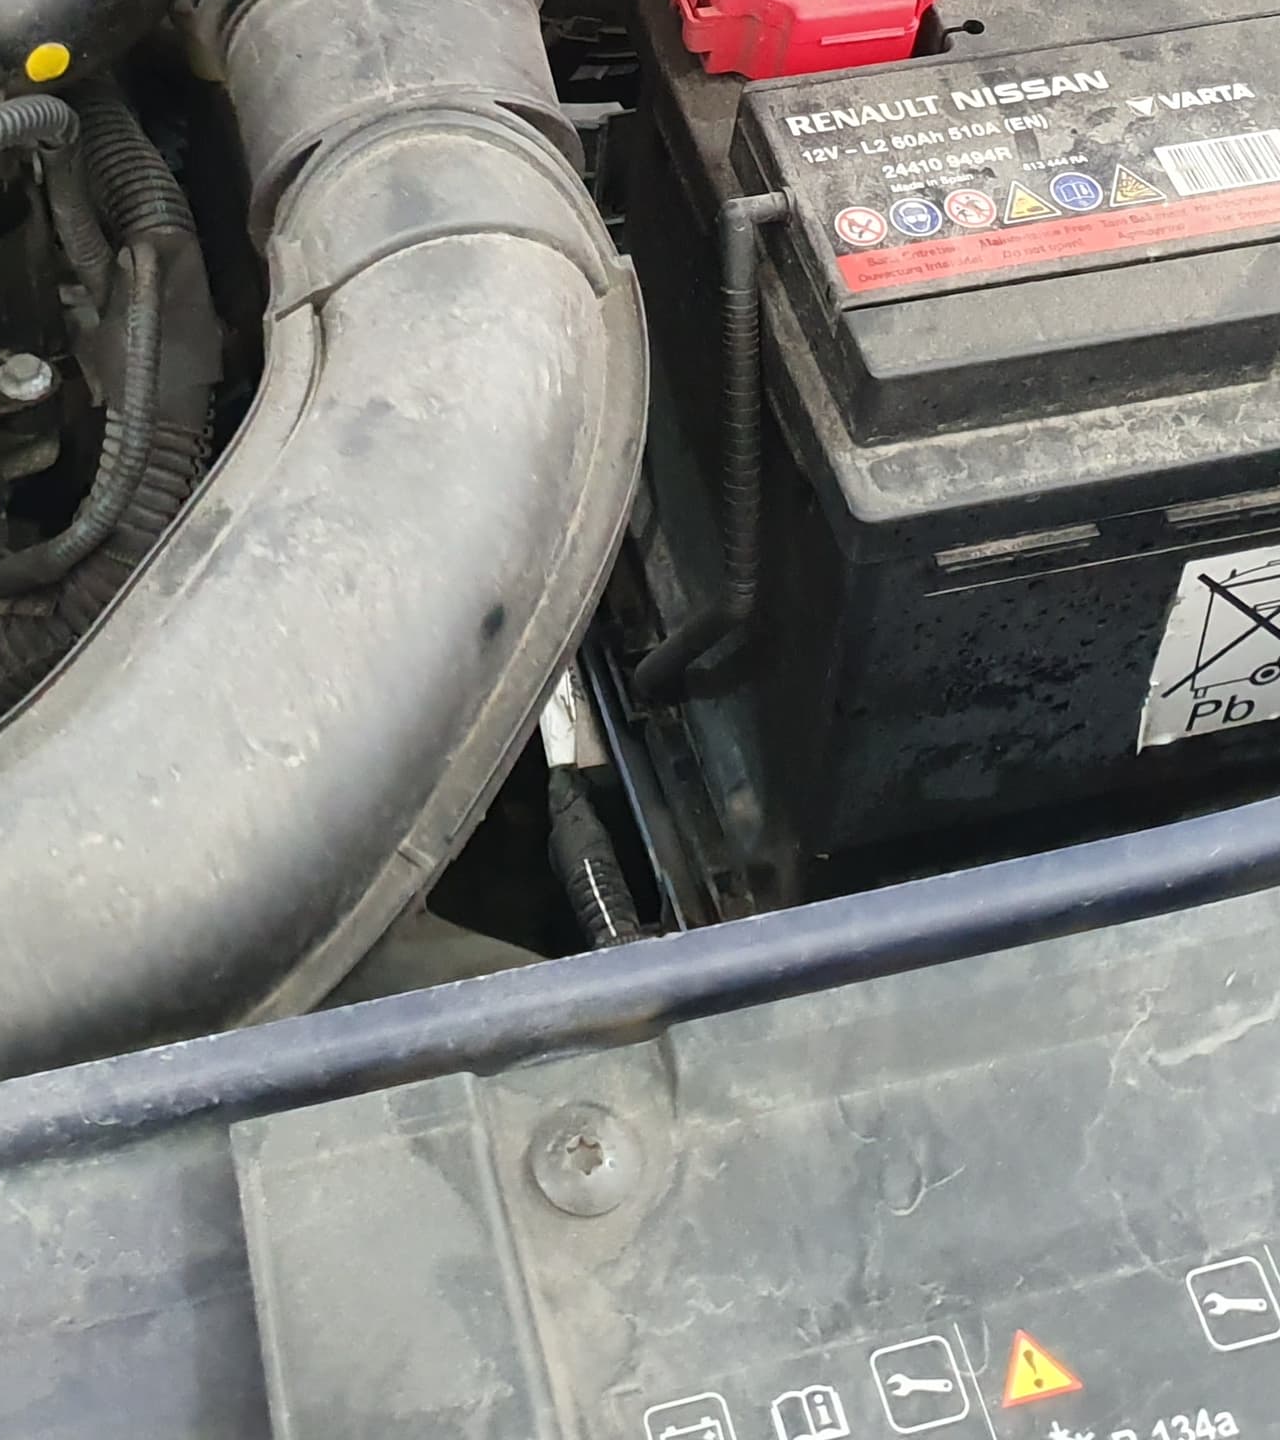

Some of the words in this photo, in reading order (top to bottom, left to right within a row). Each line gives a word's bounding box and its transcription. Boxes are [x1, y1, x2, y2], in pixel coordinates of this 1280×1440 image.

[785, 94, 940, 137] RENAULT
[950, 70, 1110, 111] NISSAN
[1158, 82, 1256, 110] VARTA
[801, 145, 841, 164] 12V
[860, 138, 889, 155] L2
[891, 130, 945, 150] 60Ah
[948, 122, 1001, 142] 510A
[1003, 113, 1049, 135] (EN)
[881, 157, 943, 180] 24410
[945, 146, 1013, 167] 9494R
[890, 180, 926, 193] Made
[926, 177, 939, 188] in
[940, 172, 975, 186] Spain
[1184, 694, 1258, 733] Pb
[1151, 1408, 1240, 1440] 134a
